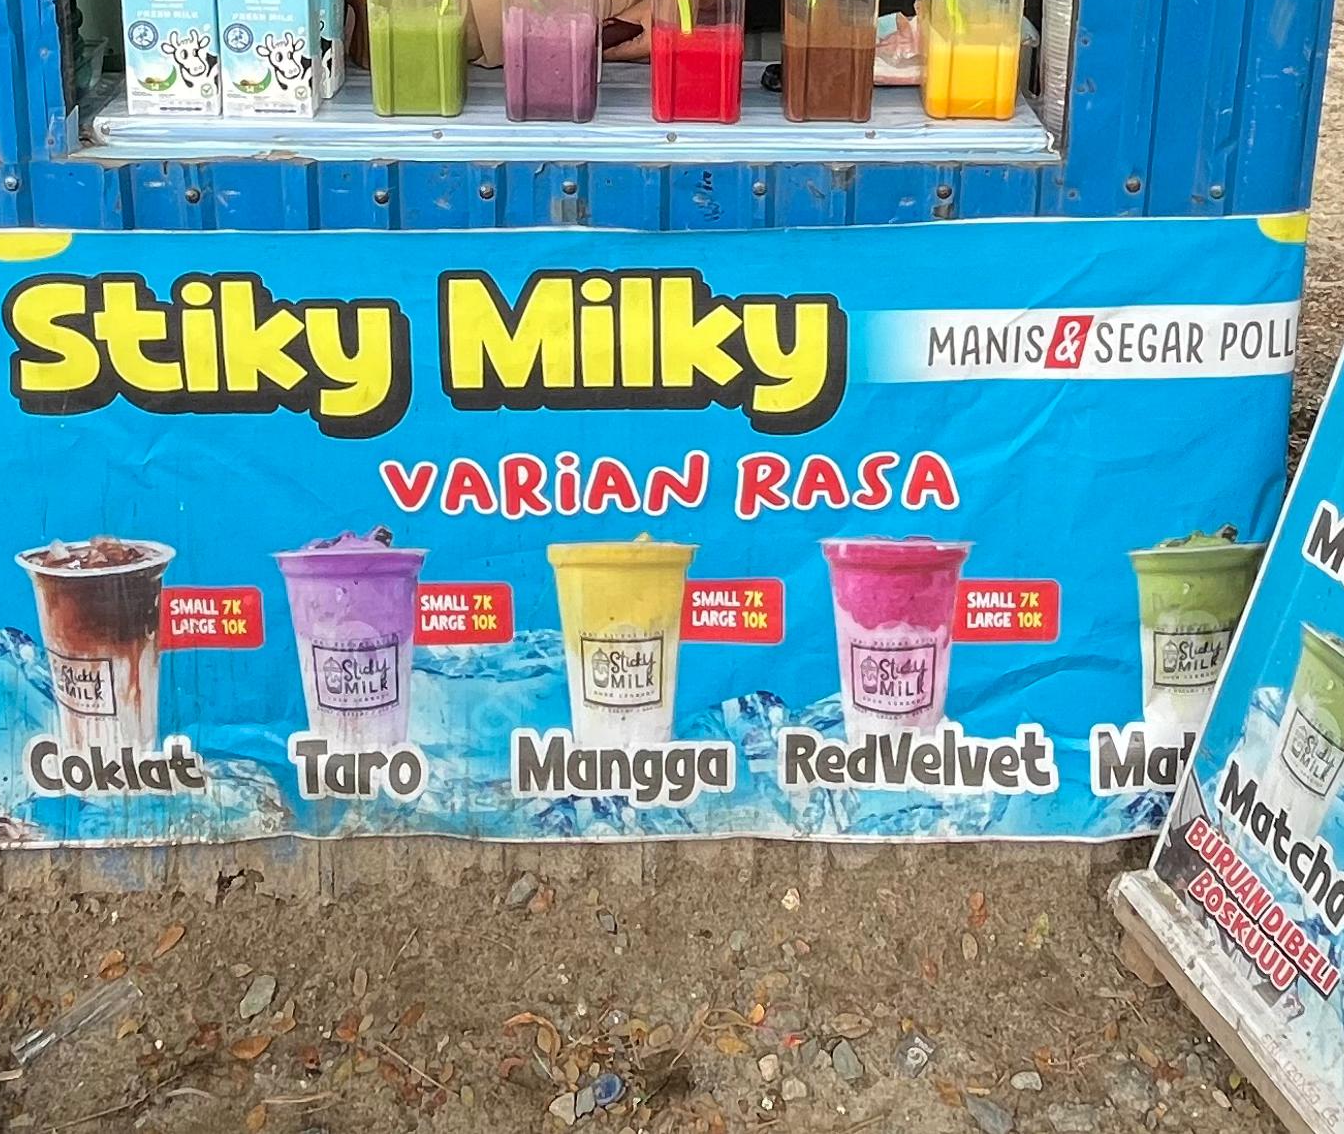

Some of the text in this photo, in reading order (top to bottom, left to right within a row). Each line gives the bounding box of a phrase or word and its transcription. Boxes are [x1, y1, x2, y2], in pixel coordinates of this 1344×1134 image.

[6, 272, 836, 423] Stiky Milky
[927, 323, 1046, 368] MANIS
[1094, 321, 1205, 365] SEGAR
[735, 449, 961, 516] RASA
[169, 597, 243, 616] SMALL 7K
[419, 594, 493, 612] SMALL 7K
[691, 590, 764, 608] SMALL 7K
[691, 610, 769, 629] LARGE 10K
[966, 591, 1040, 609] SMALL 7K
[966, 611, 1044, 629] LARGE 10K
[171, 618, 248, 636] LARGE 10K
[420, 614, 498, 632] LARGE 10K
[30, 739, 206, 793] Coklat
[295, 738, 423, 796] Taro
[517, 735, 729, 804] Mangga
[784, 728, 1052, 789] RedVelvet
[1185, 818, 1340, 993] BURUAN DIBELI
[1189, 870, 1297, 989] BOSKUUU
